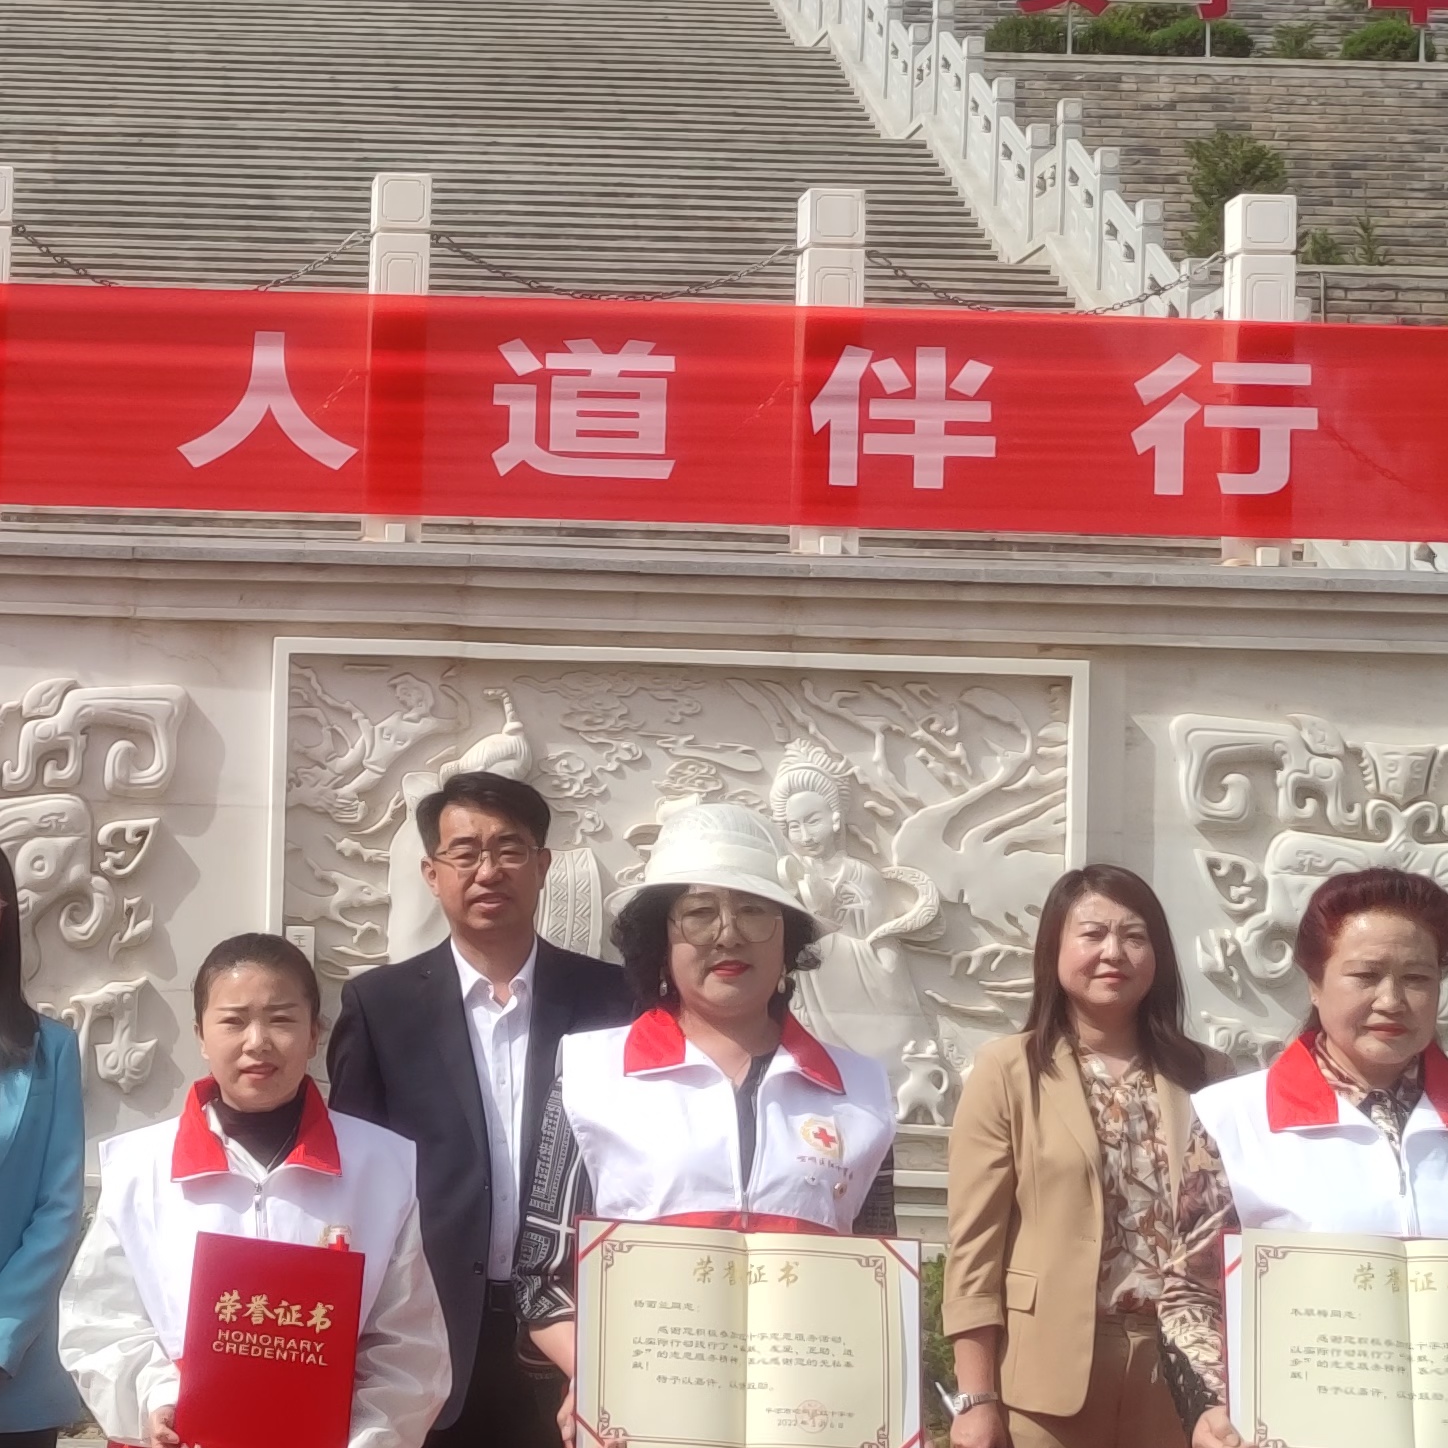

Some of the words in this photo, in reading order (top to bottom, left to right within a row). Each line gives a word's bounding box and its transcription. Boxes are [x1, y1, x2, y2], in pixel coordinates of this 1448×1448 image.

[177, 330, 1319, 497] 人道伴行
[214, 1289, 334, 1334] 荣誉证书
[212, 1341, 328, 1366] CREDENTIAL
[218, 1328, 324, 1352] HONORARY
